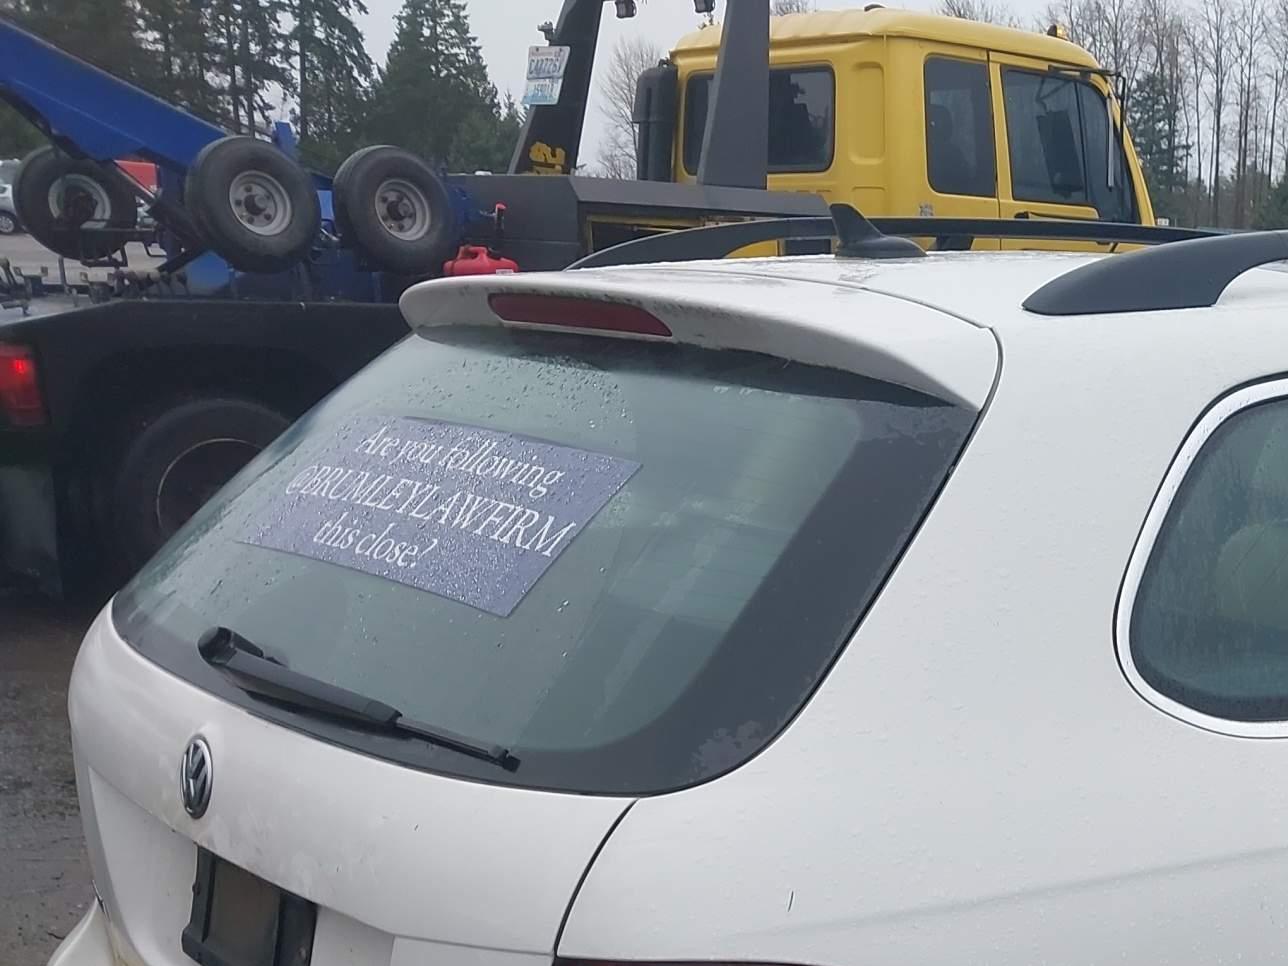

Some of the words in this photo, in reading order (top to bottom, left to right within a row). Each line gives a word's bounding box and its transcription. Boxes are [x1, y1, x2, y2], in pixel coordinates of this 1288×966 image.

[355, 426, 401, 457] Are
[389, 440, 445, 466] you
[441, 436, 565, 498] following
[285, 465, 576, 557] @BRUMLEYLAWFIRM
[313, 511, 361, 549] this
[355, 522, 438, 568] close?
